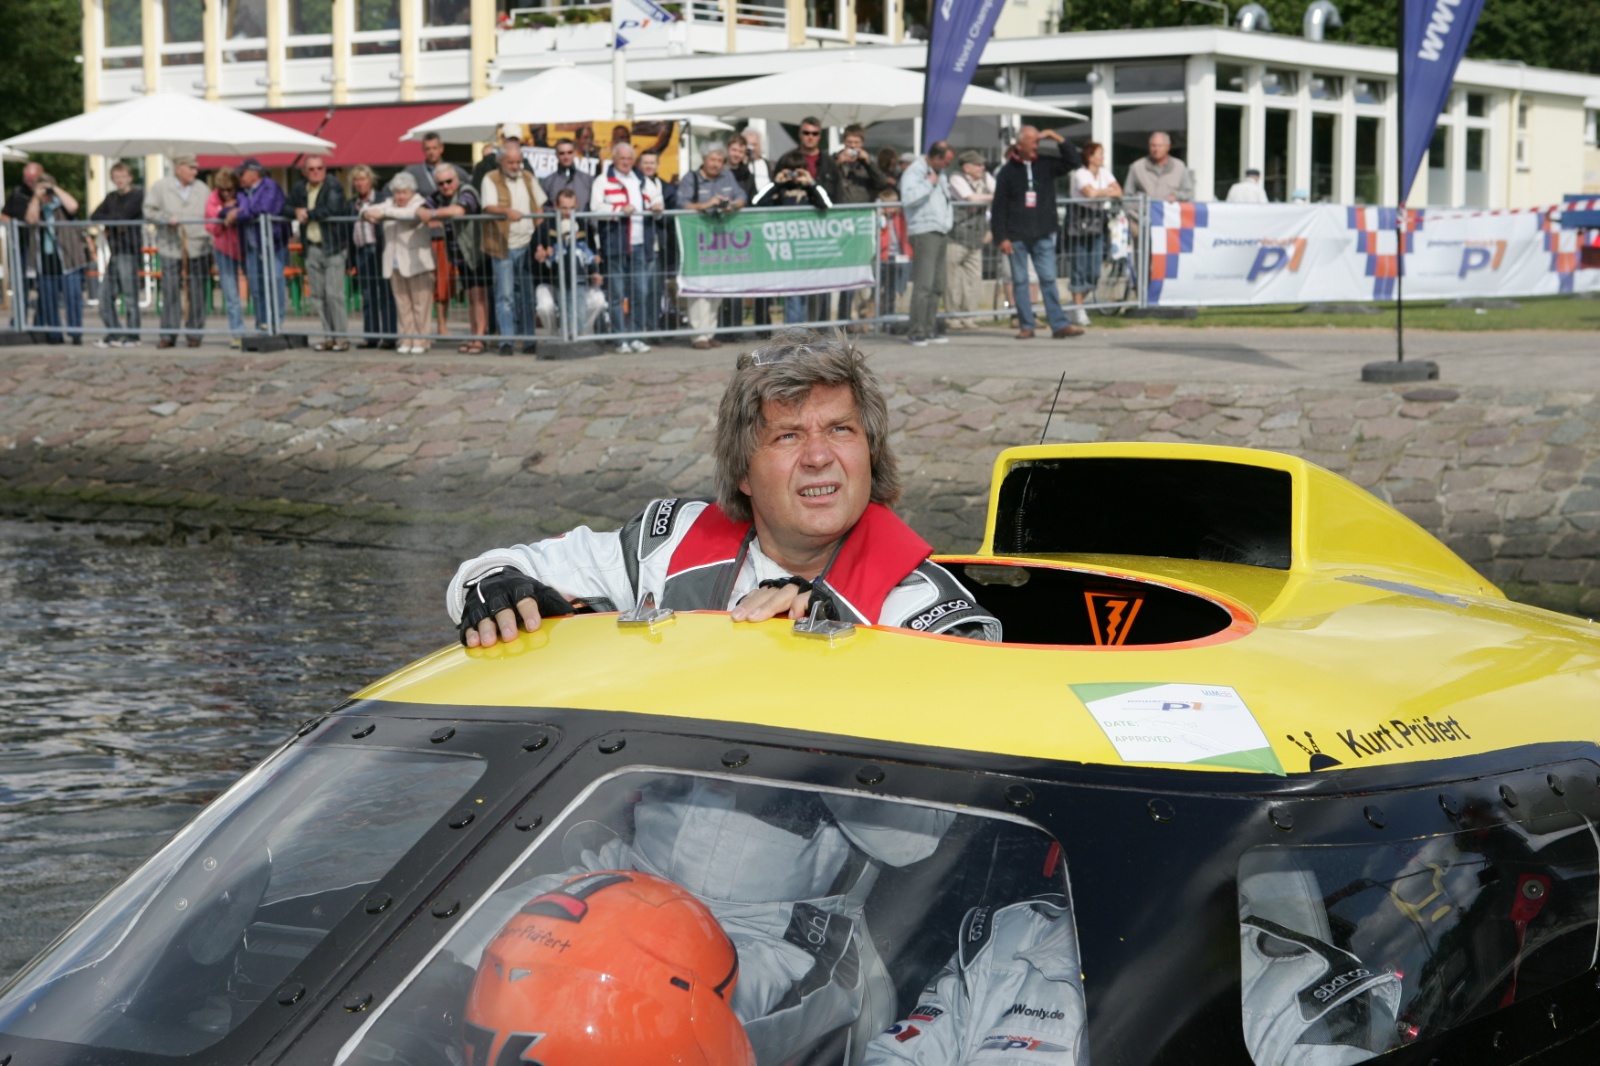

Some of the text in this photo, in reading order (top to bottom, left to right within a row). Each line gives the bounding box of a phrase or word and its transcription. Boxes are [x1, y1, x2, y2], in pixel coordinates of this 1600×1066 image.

[953, 37, 975, 73] World
[1103, 720, 1139, 728] DATE:
[1114, 735, 1176, 744] APPROVED:
[1336, 715, 1472, 759] Kurt Prüfert
